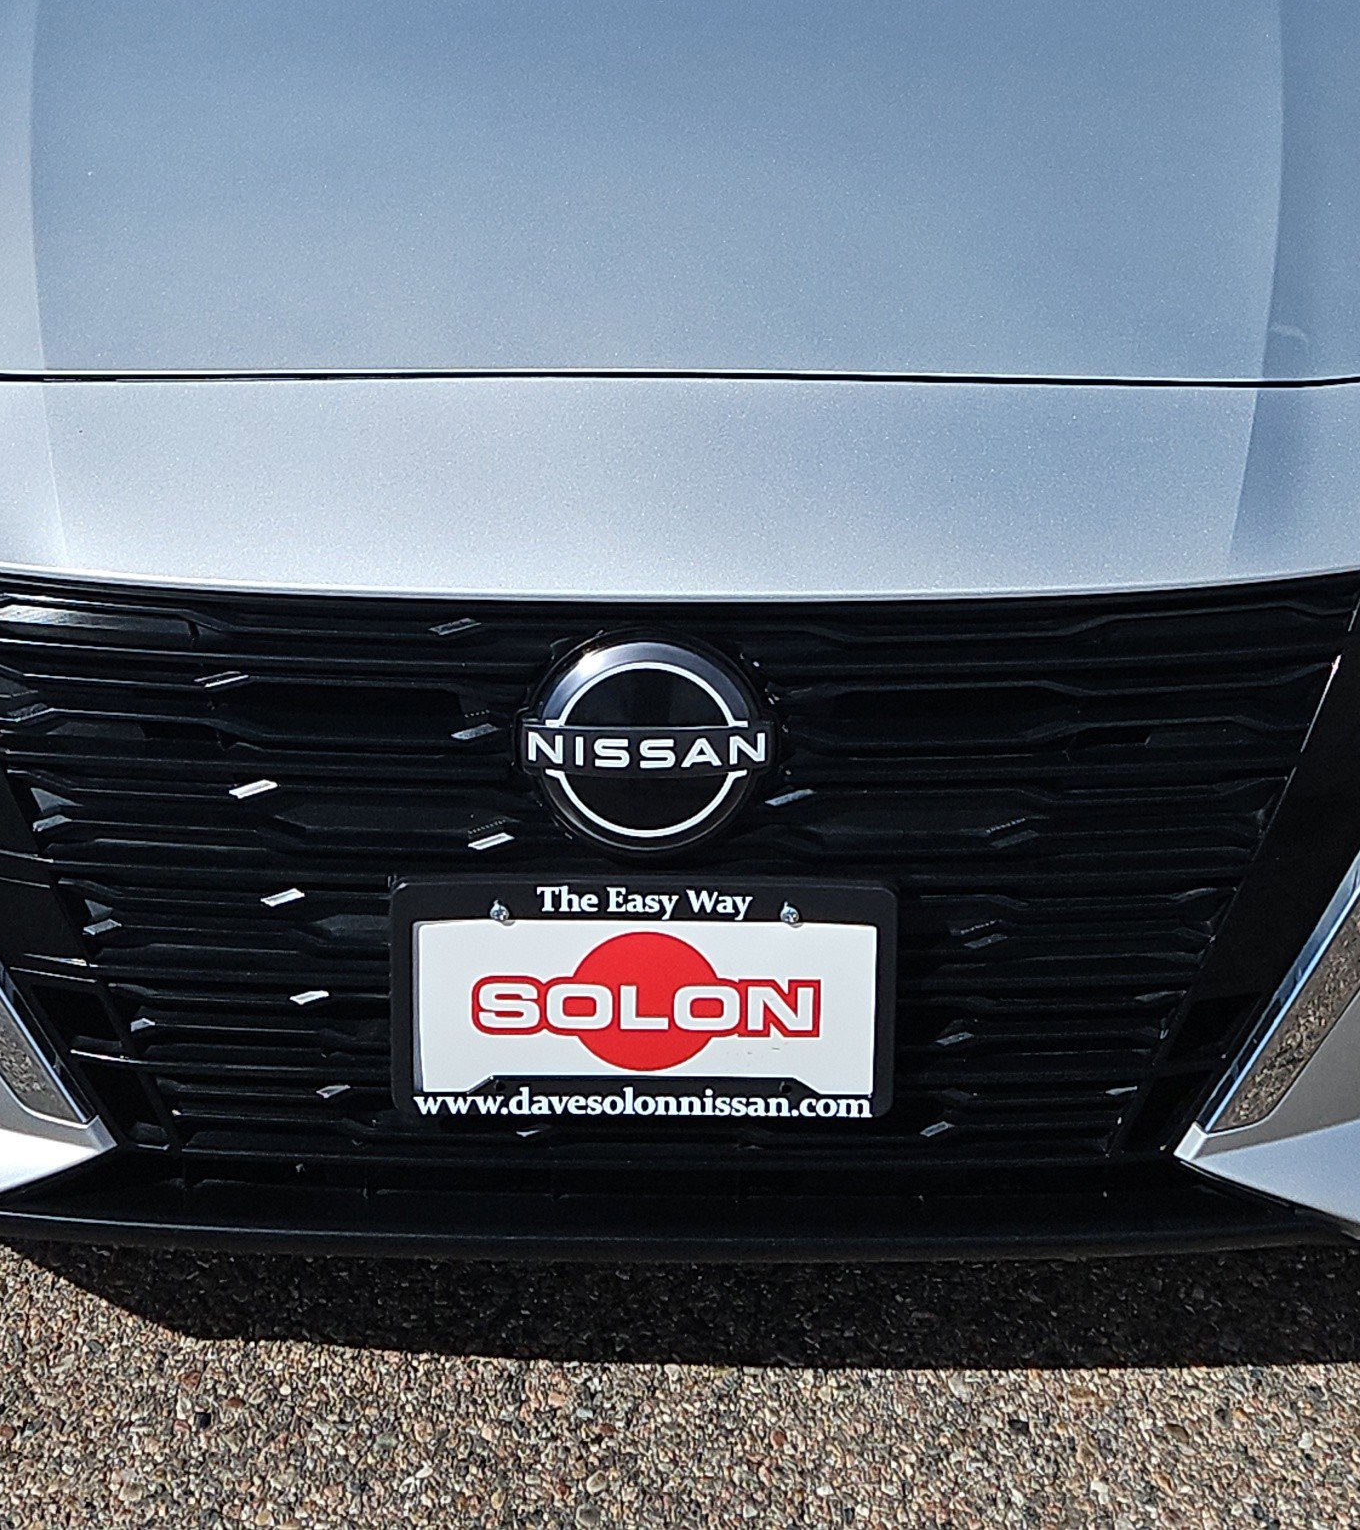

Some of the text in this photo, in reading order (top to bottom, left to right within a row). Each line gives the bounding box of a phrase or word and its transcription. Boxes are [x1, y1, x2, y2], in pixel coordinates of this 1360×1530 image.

[527, 731, 766, 769] NISSAN
[536, 886, 754, 920] The Easy Way
[473, 976, 821, 1037] SOLON
[413, 1086, 873, 1119] www.davesolonnissan.com
